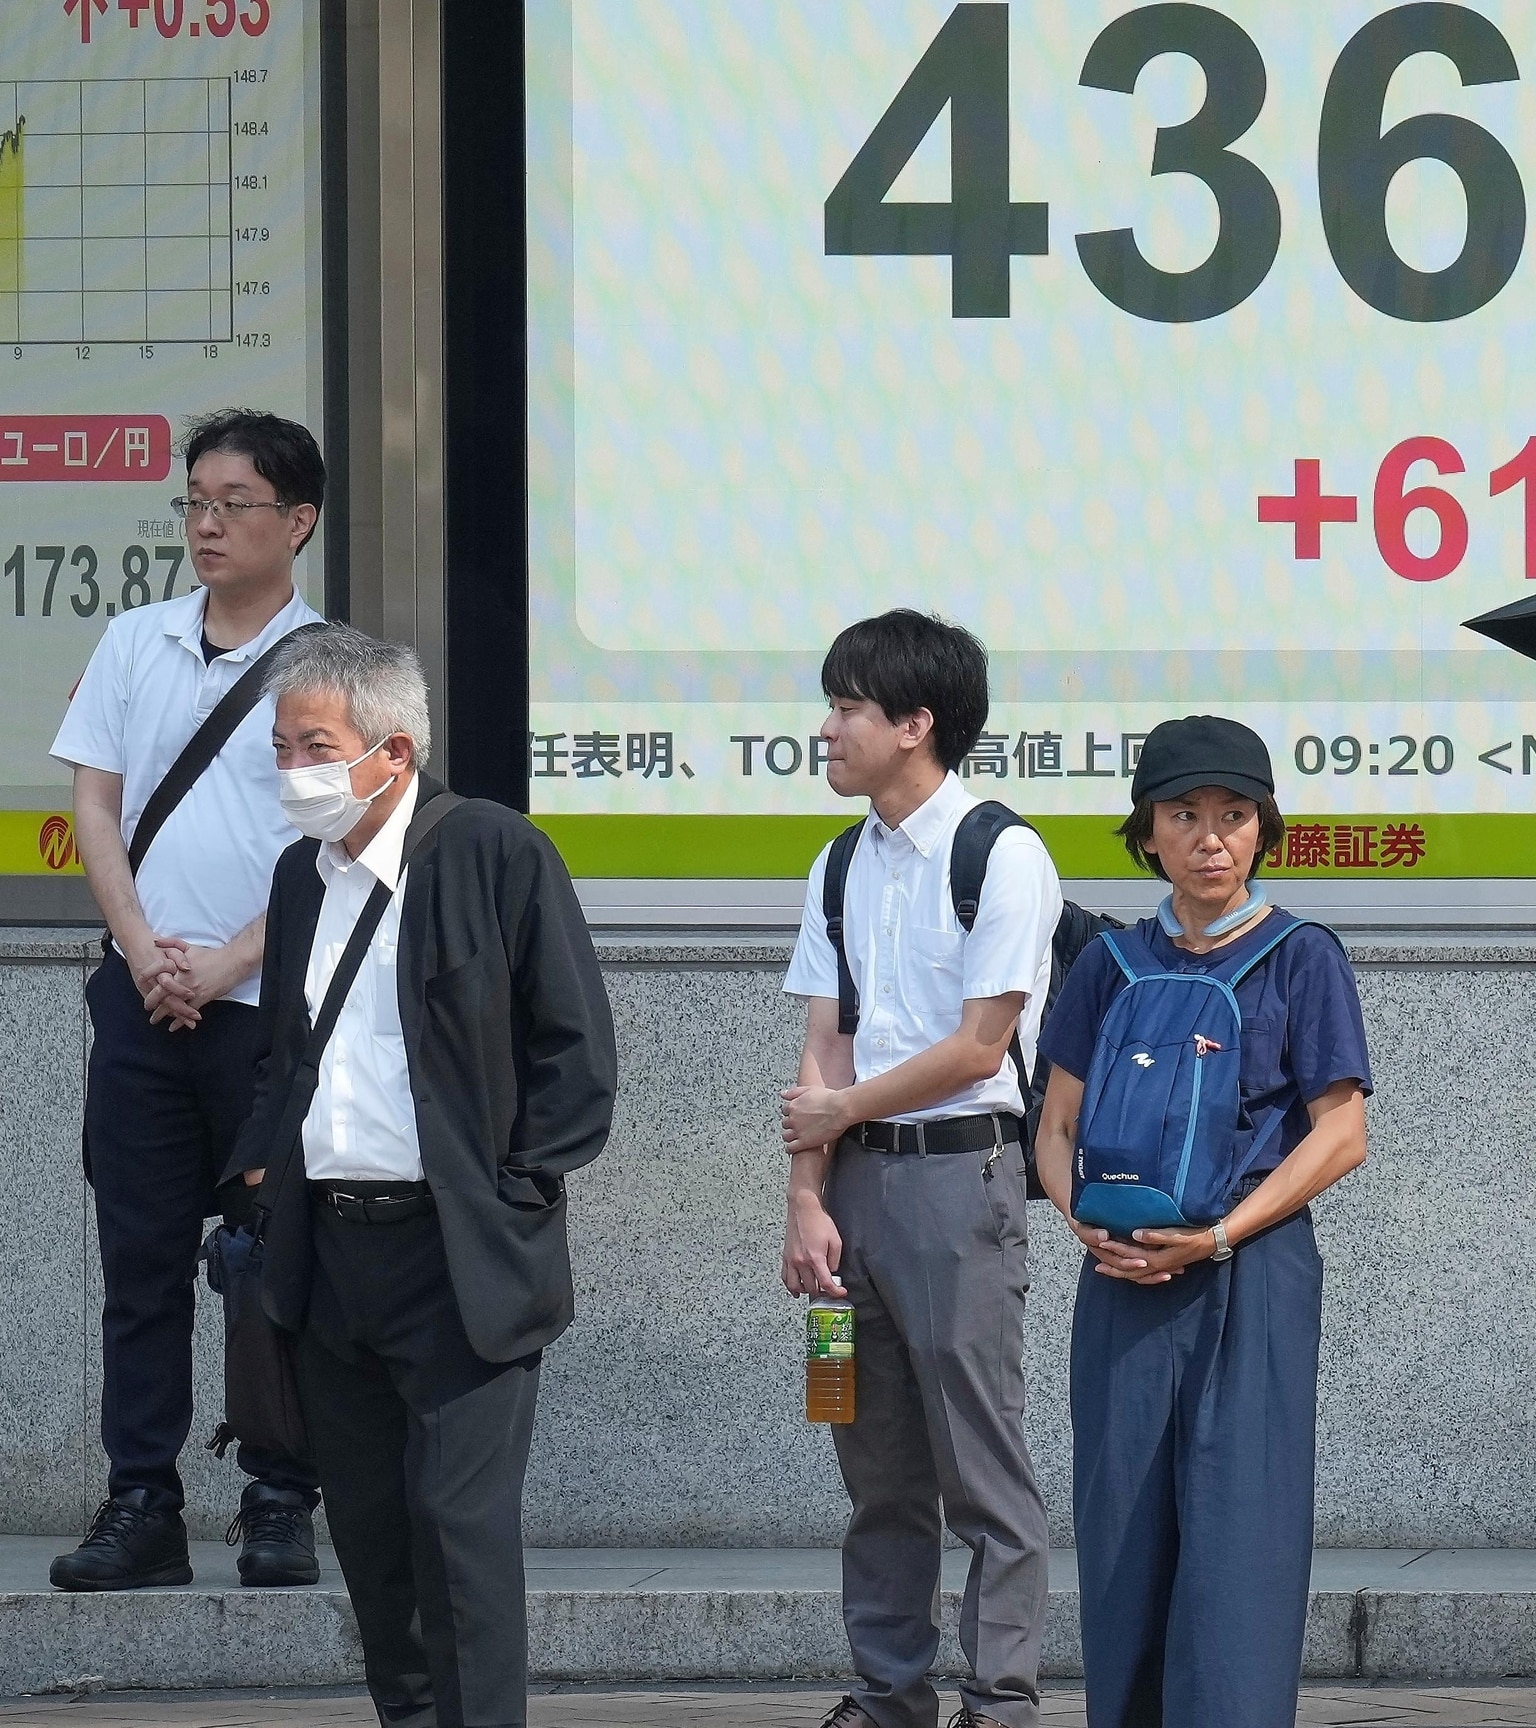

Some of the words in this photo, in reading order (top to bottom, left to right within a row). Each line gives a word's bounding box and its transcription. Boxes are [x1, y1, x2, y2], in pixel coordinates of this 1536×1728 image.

[233, 70, 269, 84] 148.7
[233, 122, 269, 136] 148.4
[234, 175, 269, 190] 148.1
[234, 228, 270, 242] 147.9
[235, 281, 271, 295] 147.6
[235, 333, 271, 347] 147.3
[13, 346, 23, 360] 9
[75, 346, 91, 360] 12
[138, 345, 154, 359] 15
[202, 344, 218, 359] 18
[1294, 734, 1455, 777] 09:20
[1266, 823, 1426, 868] 藤証券
[1101, 1172, 1140, 1181] Quechua
